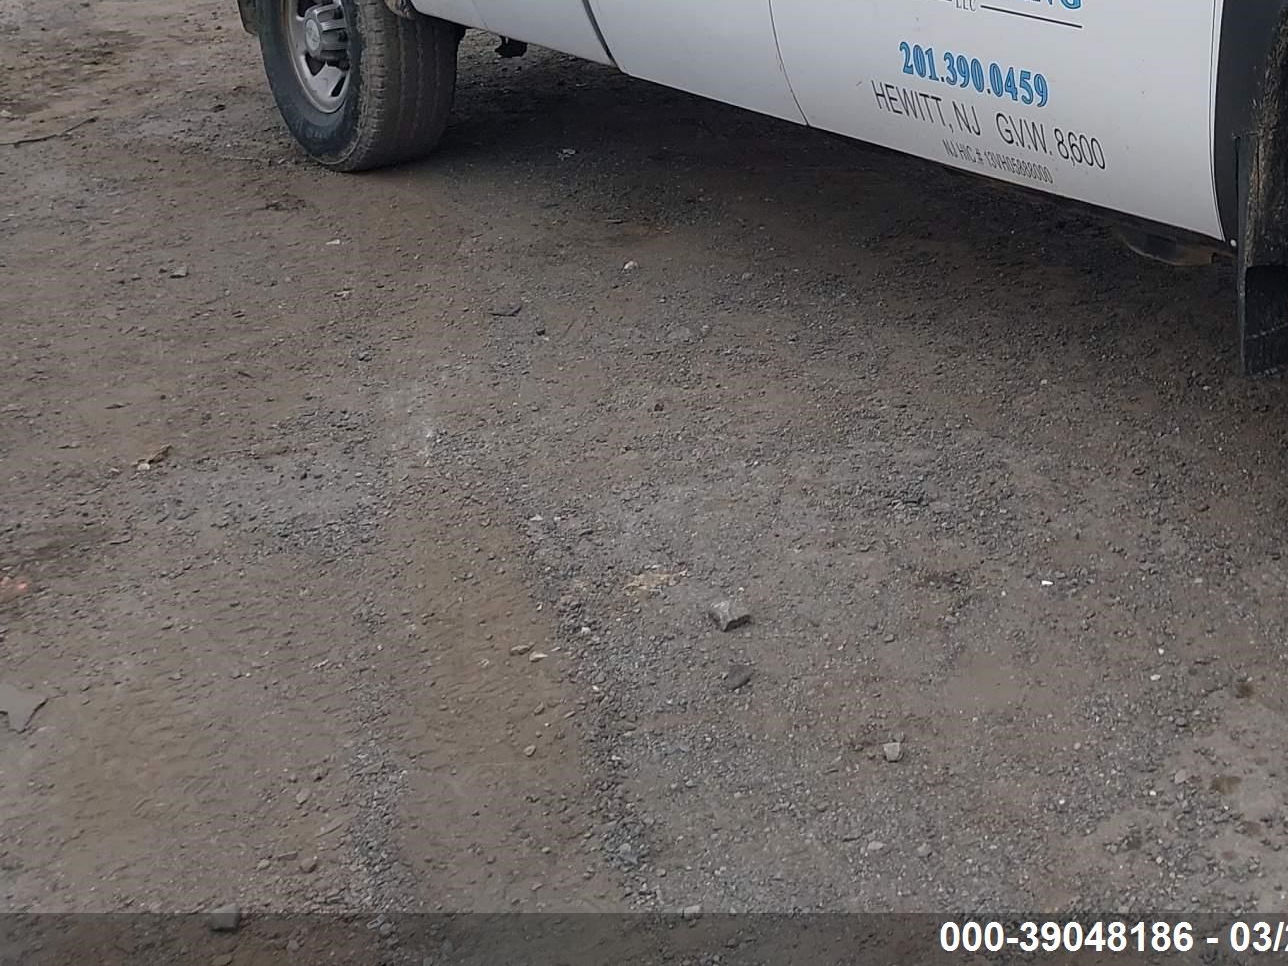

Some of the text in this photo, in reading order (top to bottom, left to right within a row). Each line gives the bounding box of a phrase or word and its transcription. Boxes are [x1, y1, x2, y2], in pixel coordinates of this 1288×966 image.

[899, 41, 1049, 108] 201.390.0459
[870, 80, 954, 135] HEWITT,
[951, 100, 982, 136] NJ
[1053, 127, 1107, 170] 8,600
[942, 138, 959, 159] NJ
